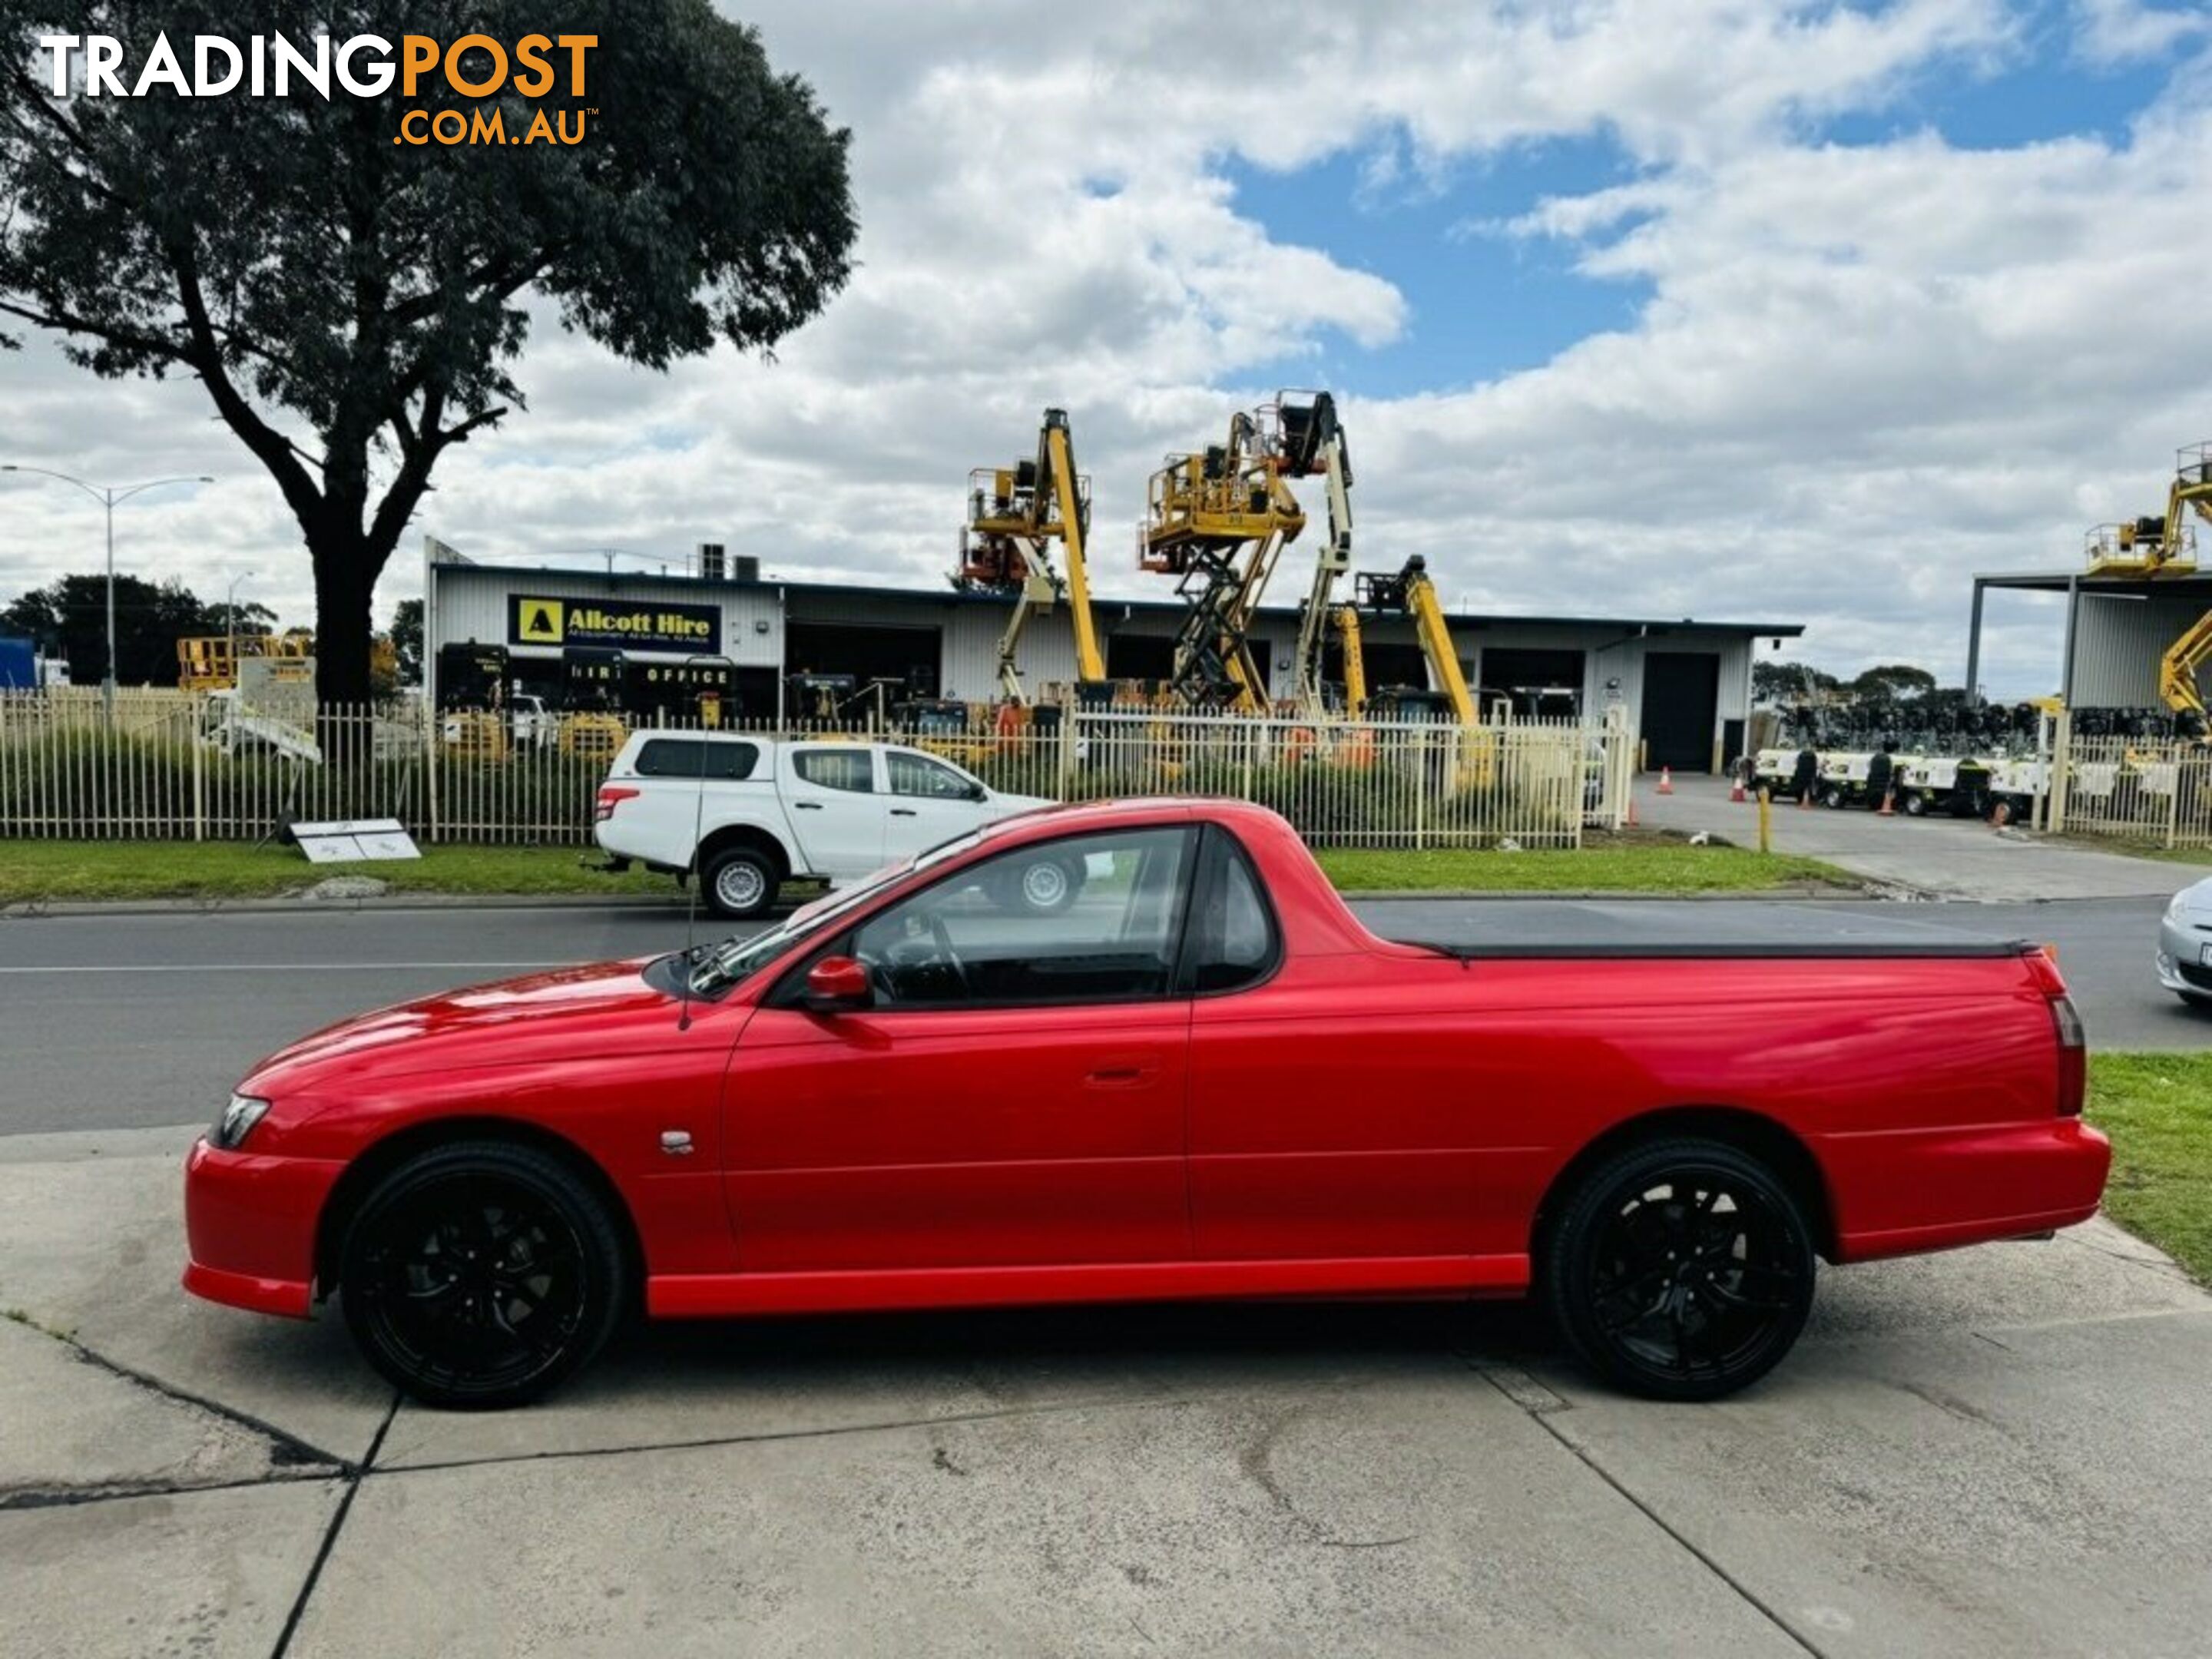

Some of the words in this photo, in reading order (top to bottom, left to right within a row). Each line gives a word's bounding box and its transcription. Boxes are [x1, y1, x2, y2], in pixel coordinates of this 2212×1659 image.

[568, 609, 651, 632] Allcott
[658, 614, 710, 636] Hire
[647, 668, 727, 684] OFFICE
